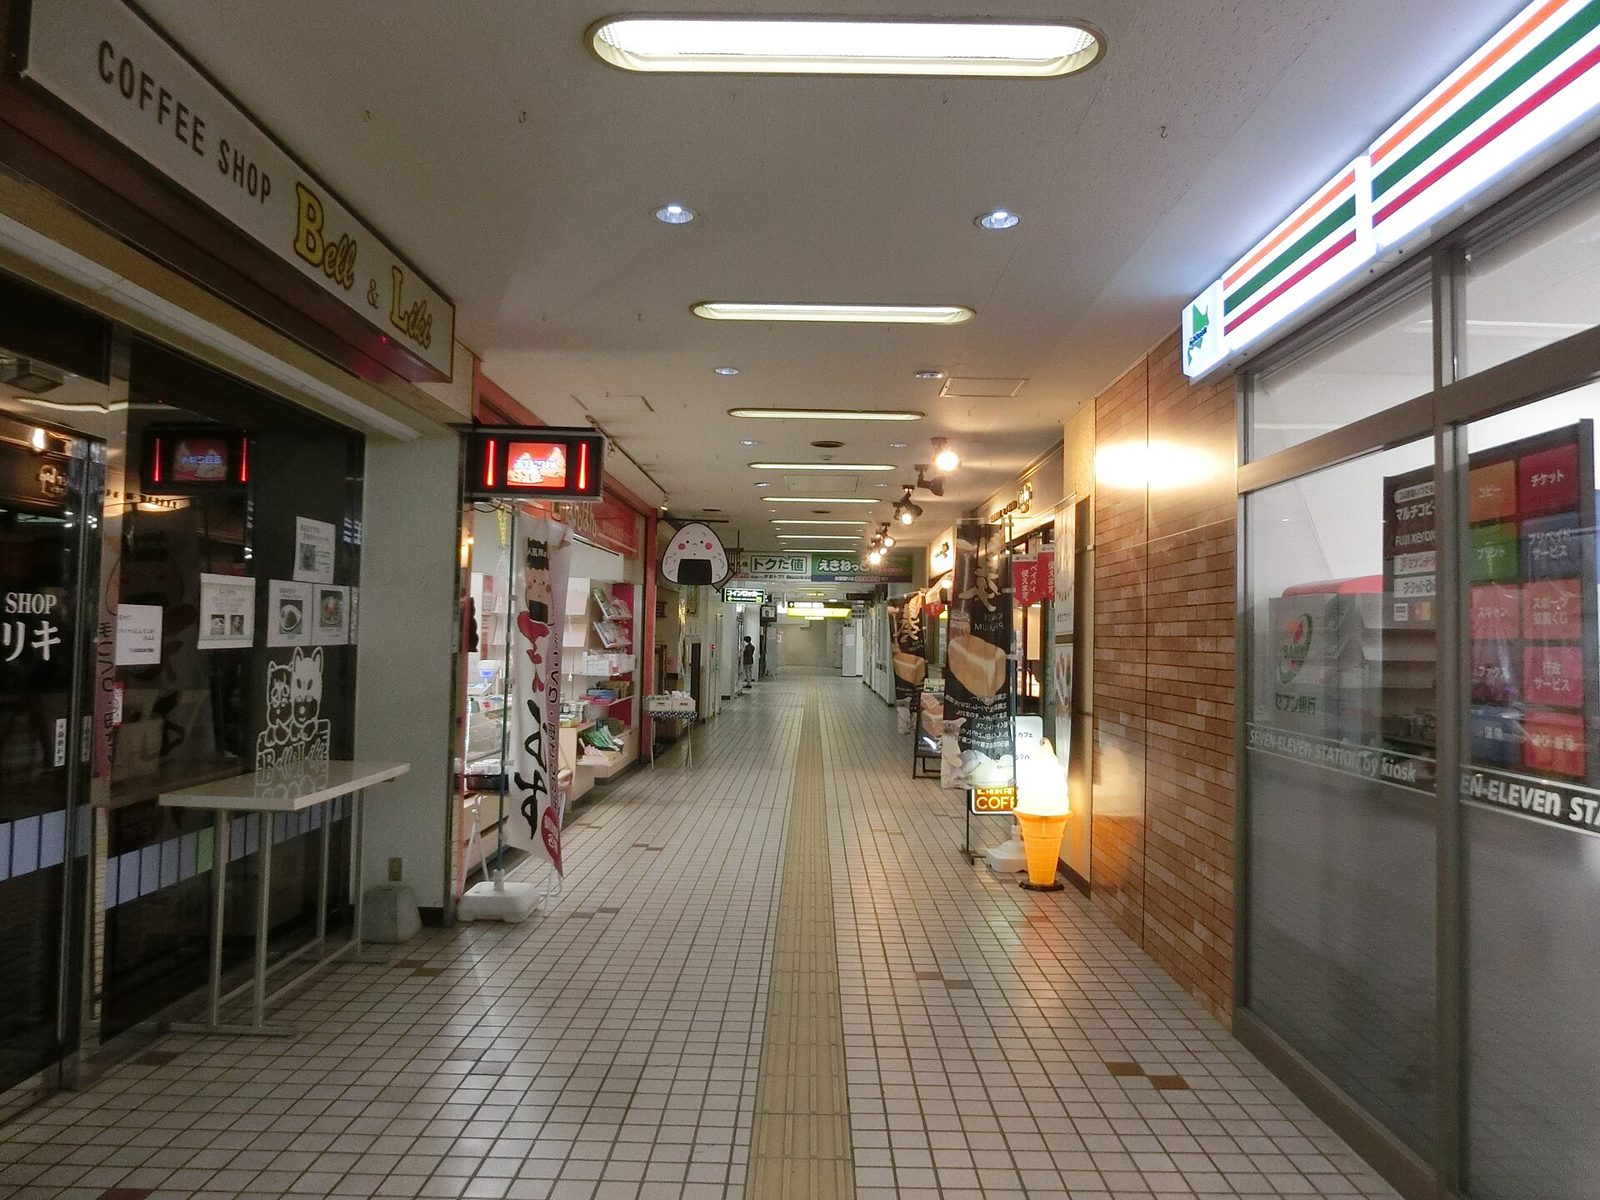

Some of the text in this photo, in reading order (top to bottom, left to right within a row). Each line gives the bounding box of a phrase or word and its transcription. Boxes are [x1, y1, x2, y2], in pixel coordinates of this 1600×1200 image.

[98, 40, 206, 158] COFFEE
[217, 139, 271, 204] SHOP
[294, 181, 357, 291] Bell
[366, 278, 379, 310] &
[1531, 469, 1564, 487] チケット
[1479, 485, 1501, 498] コピー
[1395, 499, 1436, 521] マルチコピ
[6, 592, 57, 614] SHOP
[3, 620, 61, 662] リキ
[1381, 756, 1416, 782] kiosk
